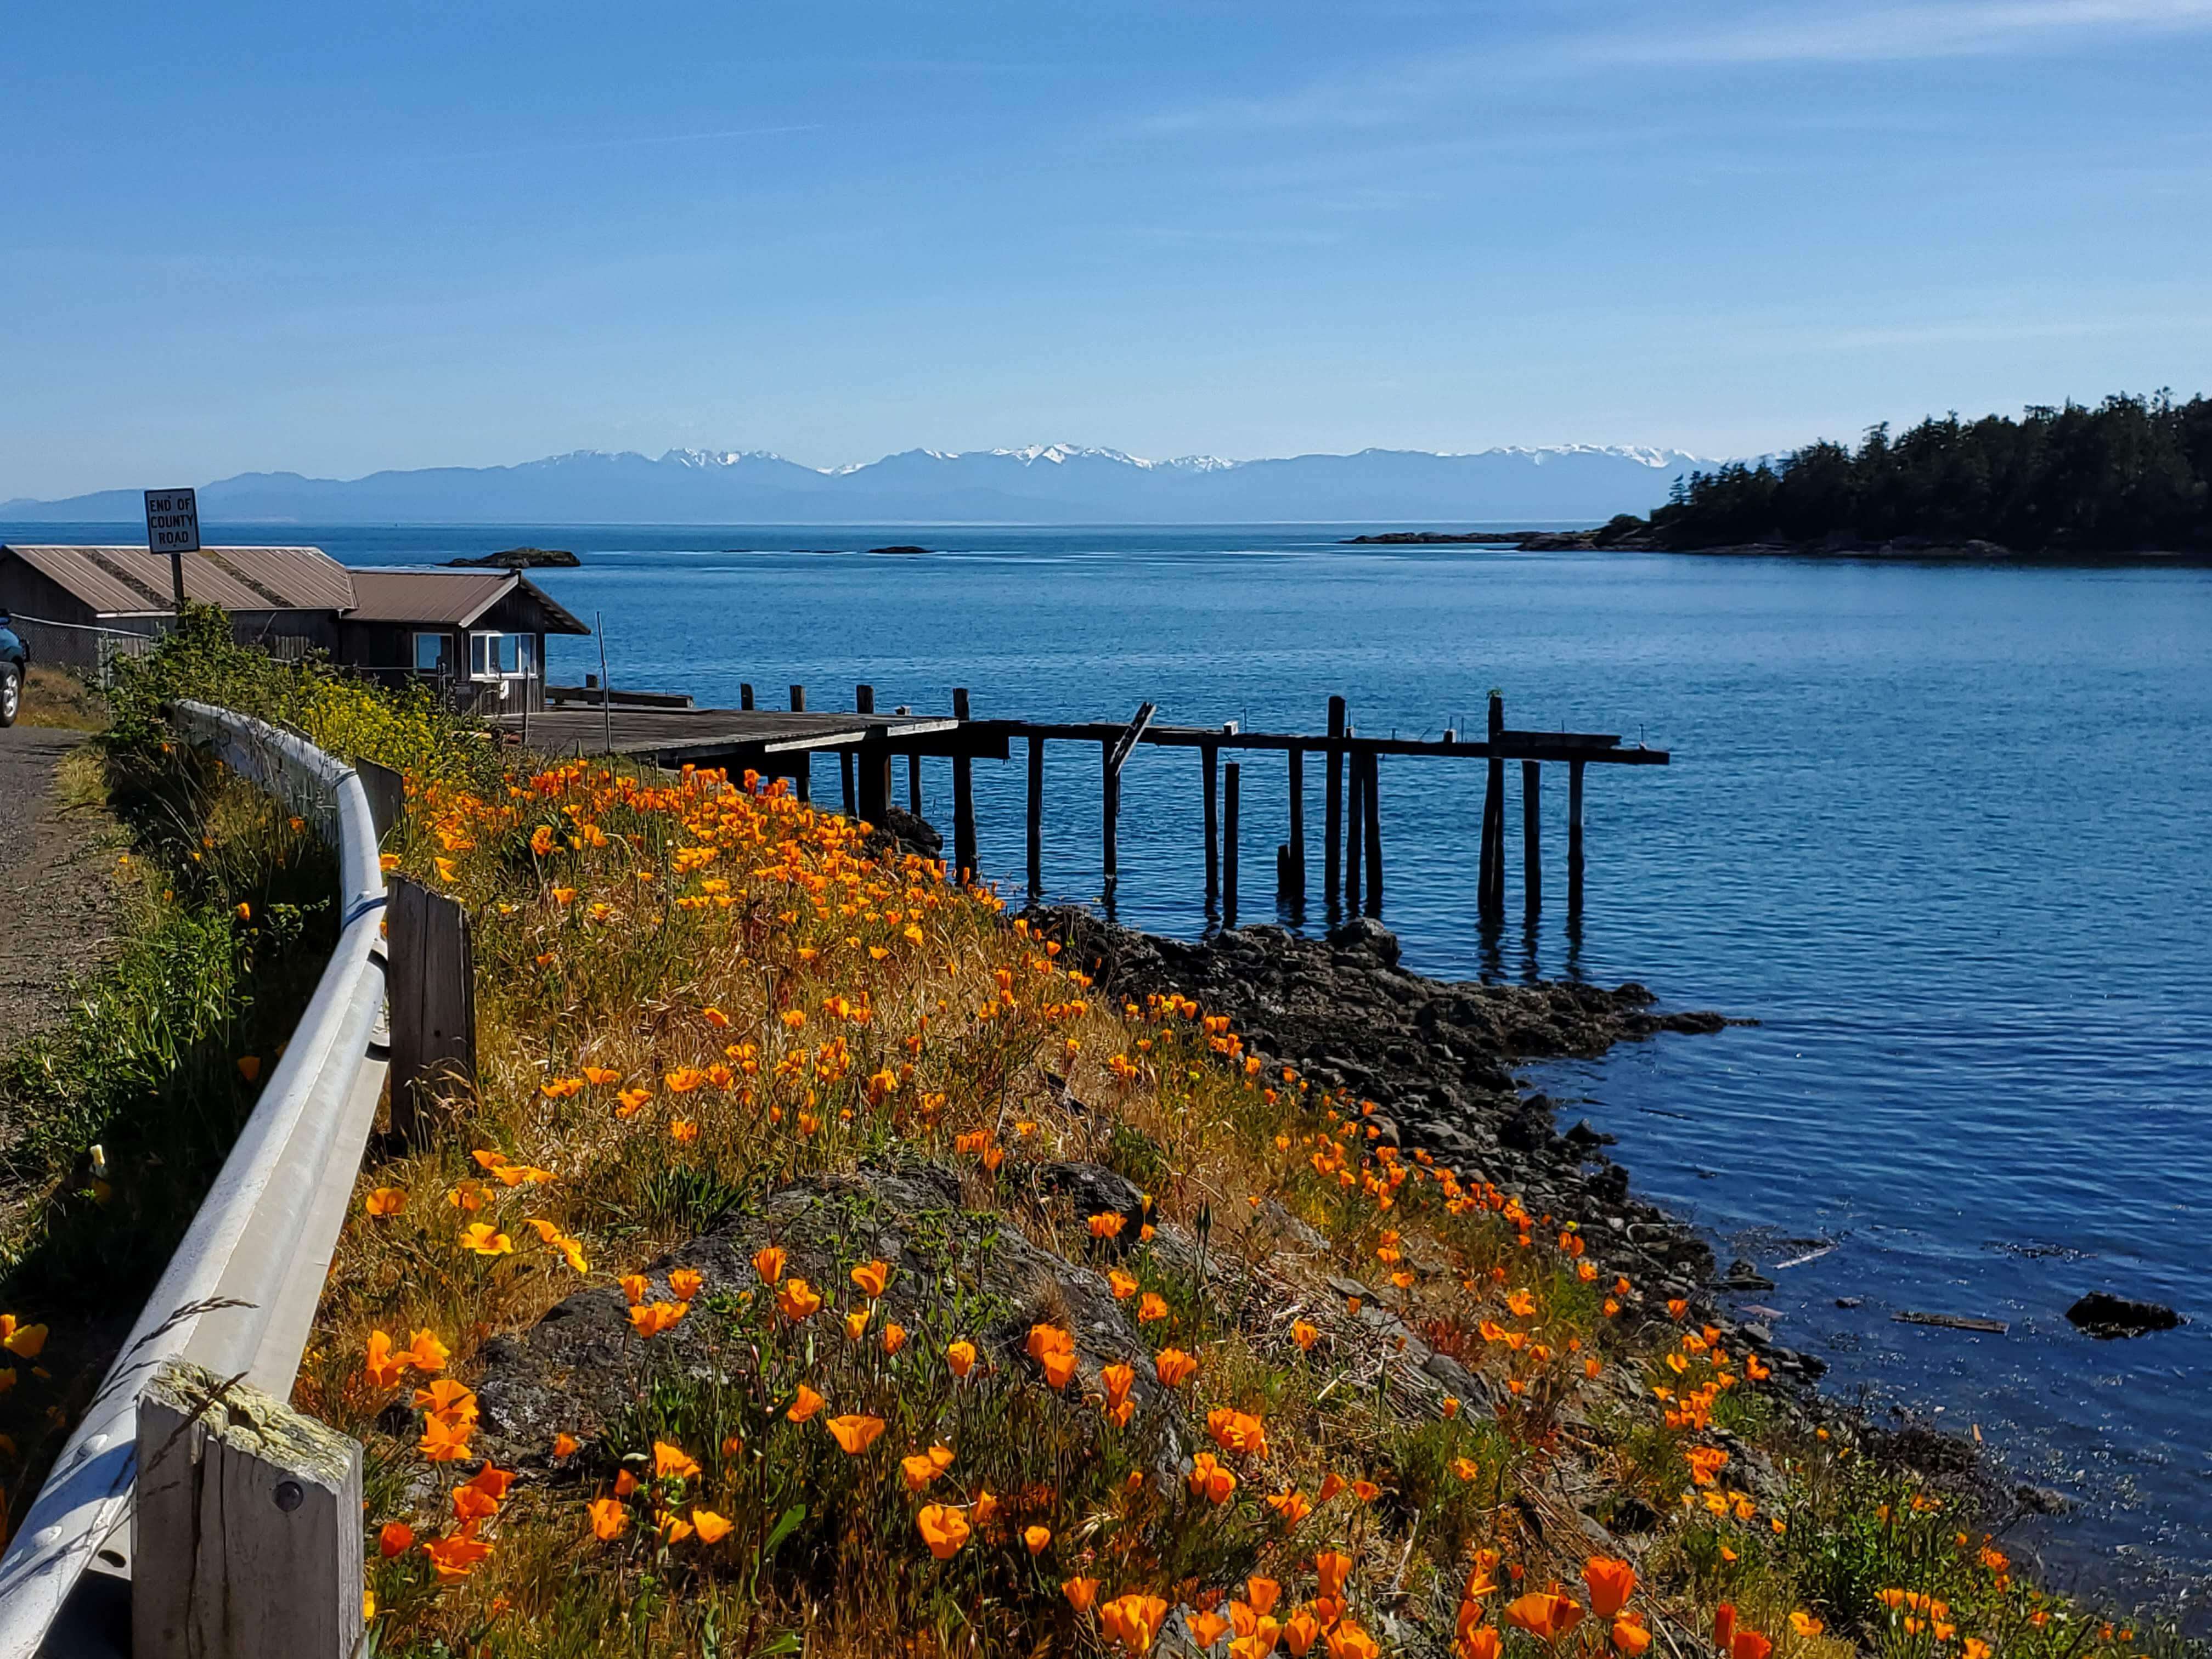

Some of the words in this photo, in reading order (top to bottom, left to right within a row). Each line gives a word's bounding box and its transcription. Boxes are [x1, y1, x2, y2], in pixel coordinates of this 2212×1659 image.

[150, 499, 171, 512] END
[177, 498, 191, 511] OF
[151, 515, 193, 528] COUNTY
[158, 531, 189, 544] ROAD
